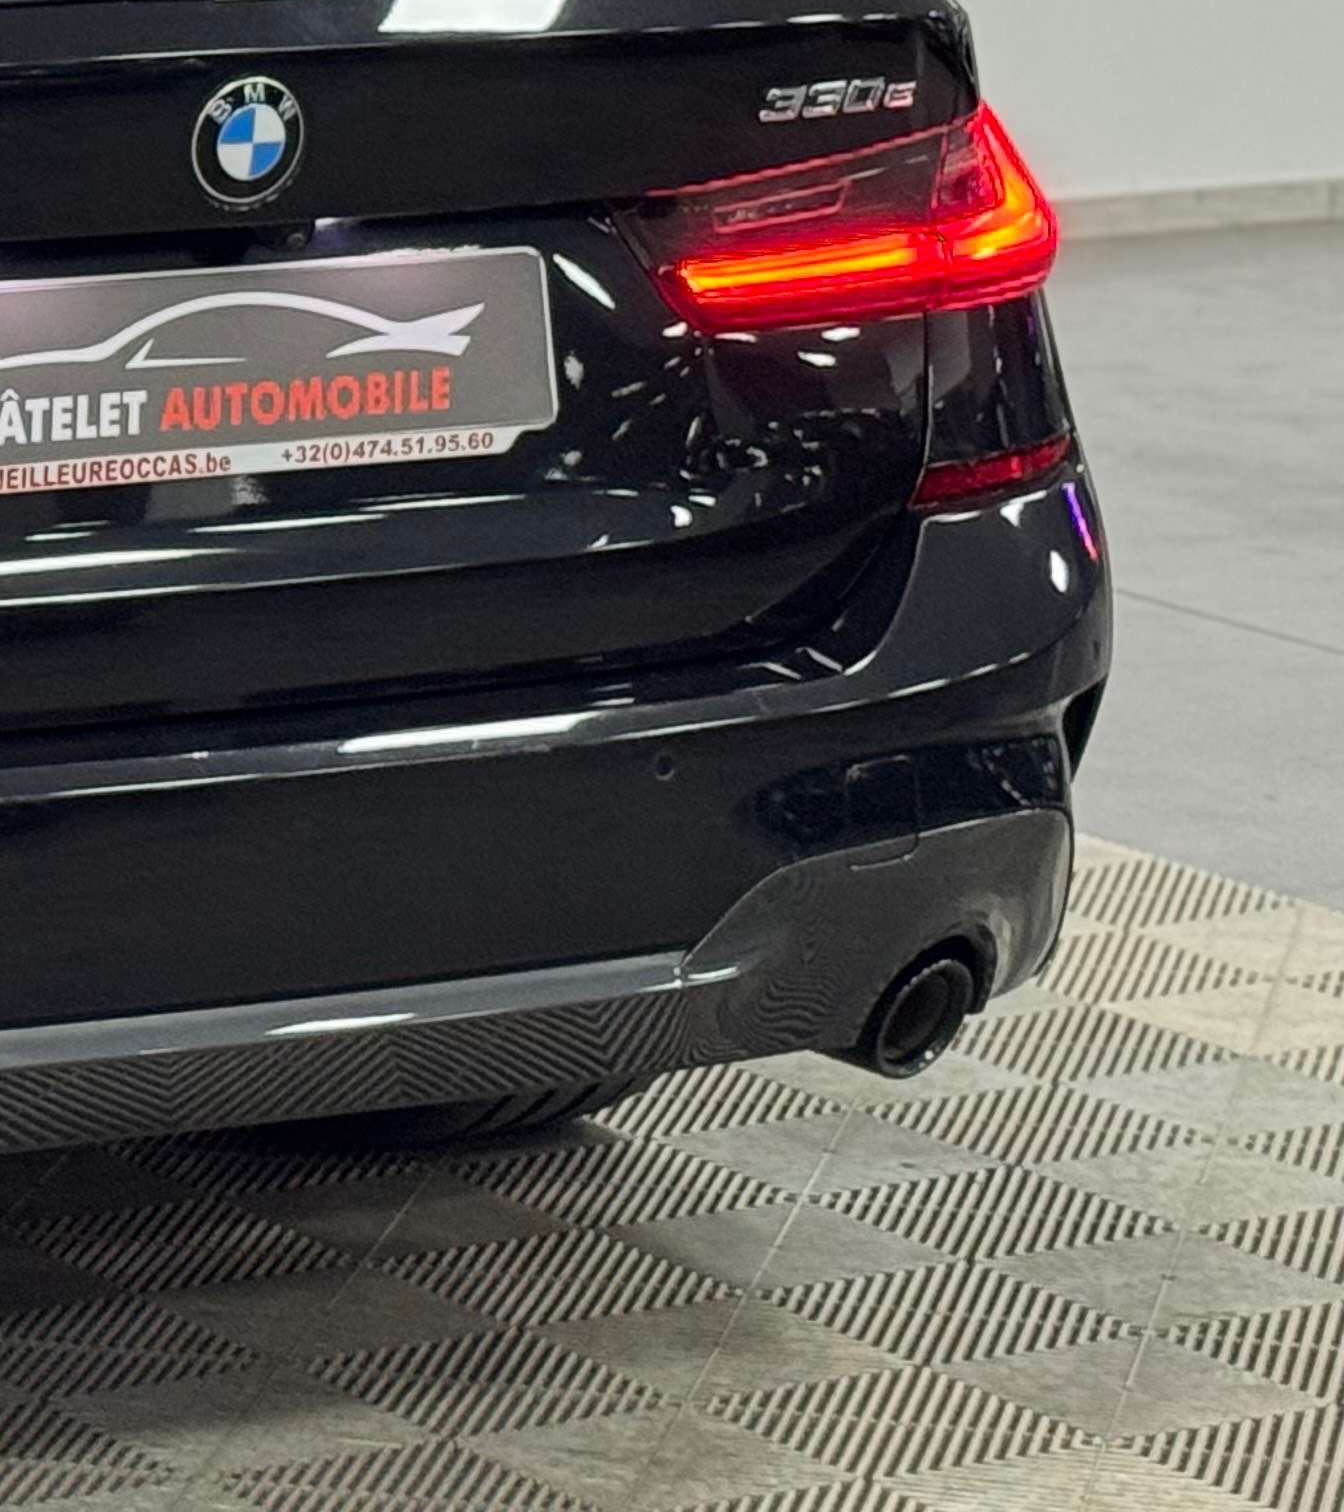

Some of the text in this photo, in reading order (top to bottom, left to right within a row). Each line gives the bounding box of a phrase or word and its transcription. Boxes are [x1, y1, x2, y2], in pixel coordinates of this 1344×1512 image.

[207, 81, 298, 125] BMW
[759, 76, 917, 123] 330e
[159, 366, 452, 433] AUTOMOBILE
[280, 430, 496, 465] +32(0)474.51.95.60
